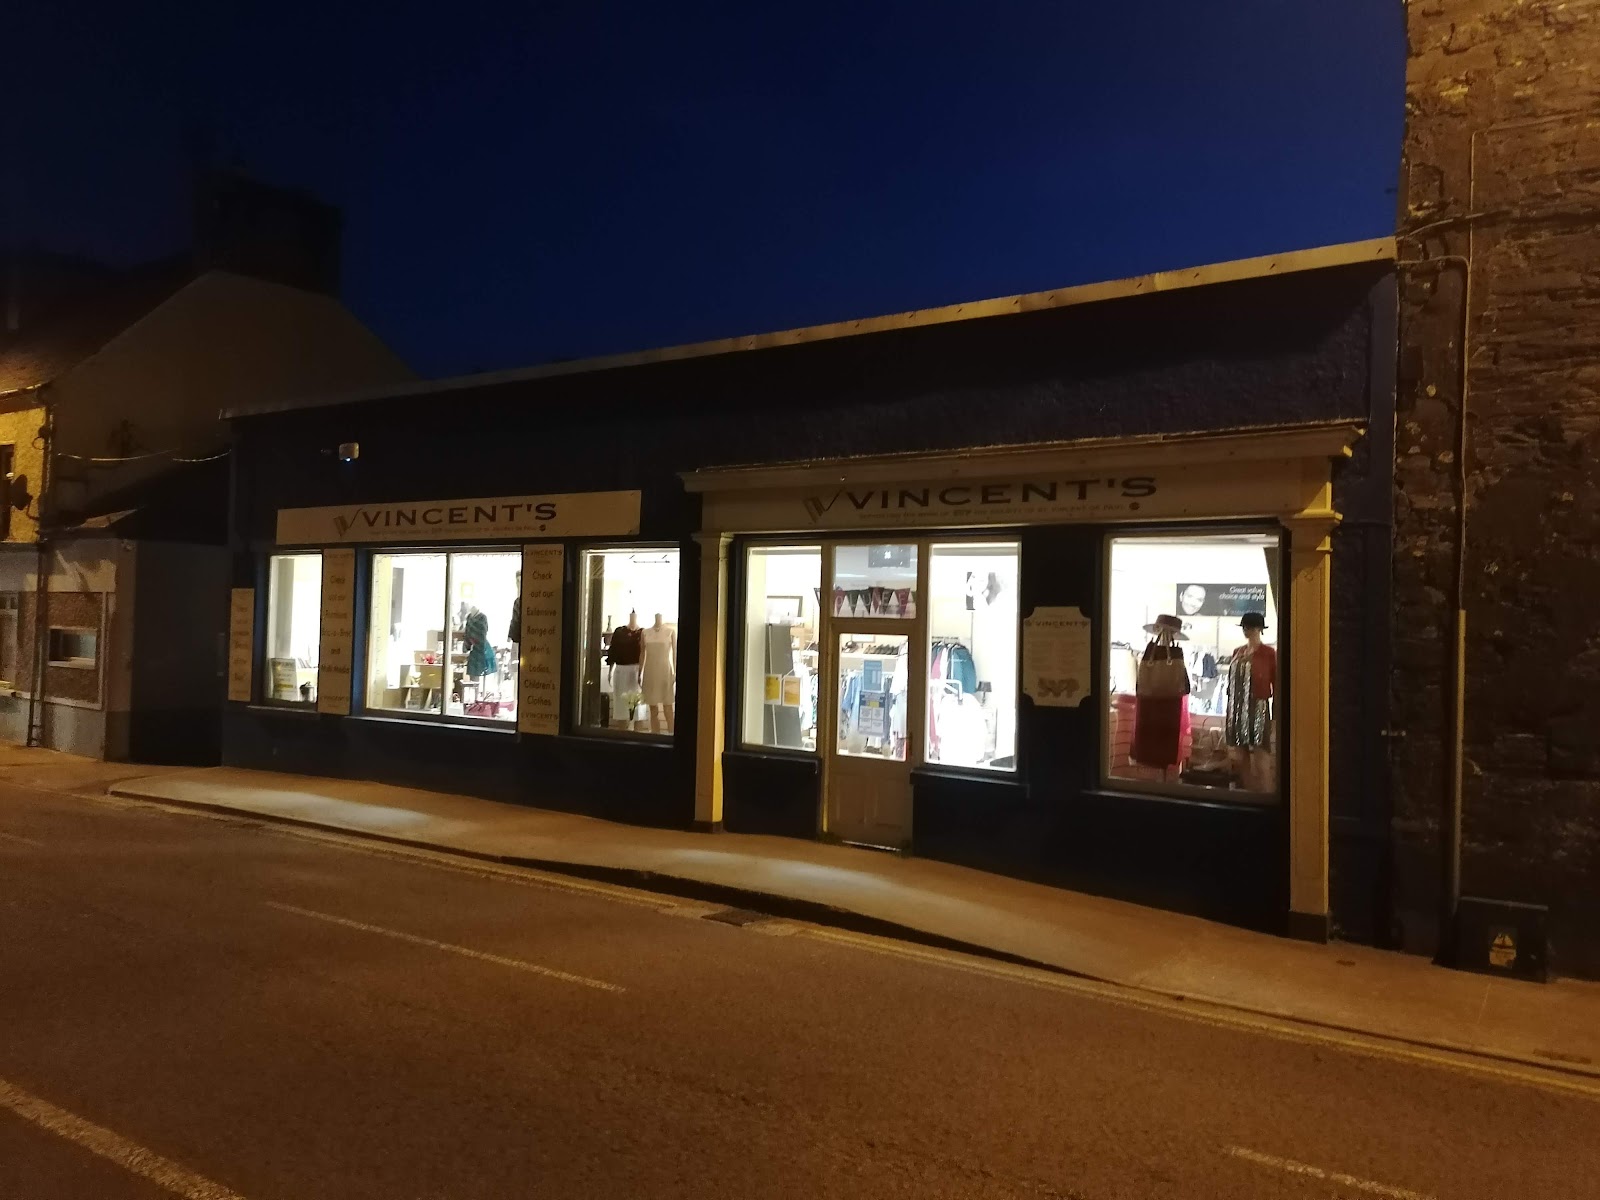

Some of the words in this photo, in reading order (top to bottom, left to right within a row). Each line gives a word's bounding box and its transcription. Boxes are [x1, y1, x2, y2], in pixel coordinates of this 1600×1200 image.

[846, 477, 1157, 510] VINCENT'S
[362, 503, 557, 527] VINCENT'S
[532, 570, 553, 580] Check
[1229, 586, 1247, 594] Great
[526, 607, 557, 617] Extensive
[527, 626, 547, 637] Range
[547, 625, 556, 635] of
[524, 679, 555, 690] Children's
[526, 695, 552, 706] Clothes
